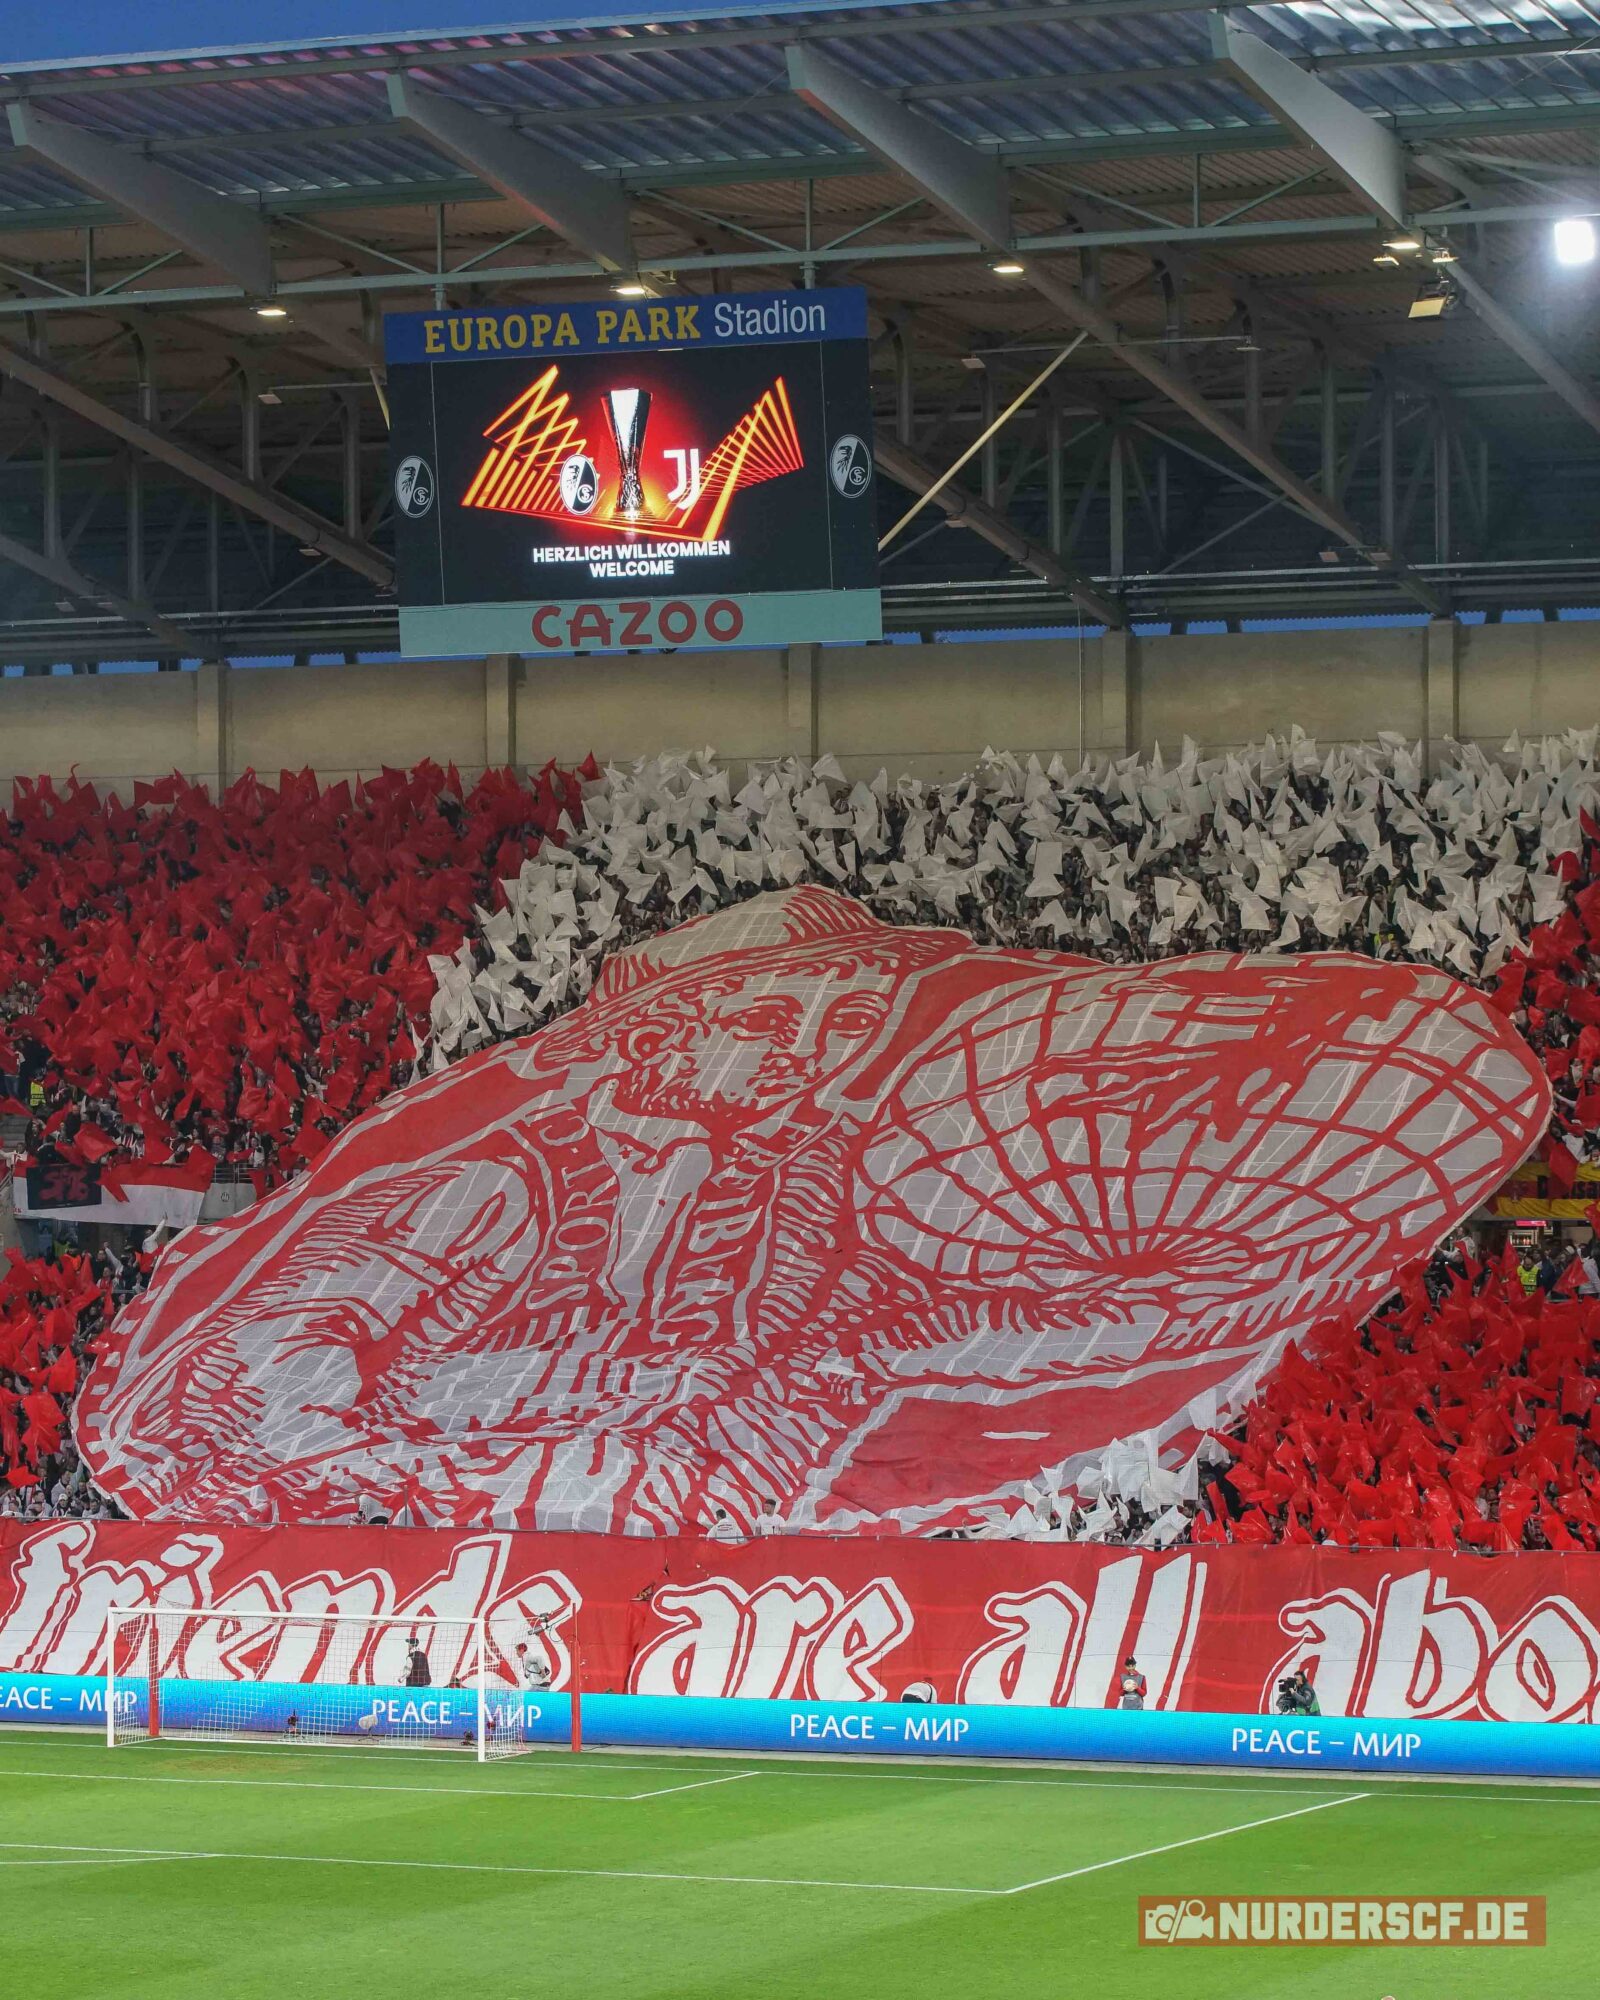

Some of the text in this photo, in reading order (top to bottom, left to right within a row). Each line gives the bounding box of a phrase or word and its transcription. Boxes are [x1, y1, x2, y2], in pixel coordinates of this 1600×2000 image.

[424, 300, 826, 353] EUROPA PARK Stadion
[533, 540, 730, 564] HERZLICH WILLKOMMEN
[589, 559, 674, 578] WELCOME
[531, 599, 744, 648] CAZOO
[0, 1520, 583, 1695] friends
[628, 1575, 914, 1702] are
[955, 1552, 1207, 1711] all
[372, 1699, 452, 1725] PEACE
[790, 1713, 874, 1740] PEACE
[904, 1717, 969, 1742] МИР
[1232, 1727, 1322, 1755] PEACE
[1353, 1731, 1422, 1758] МИР
